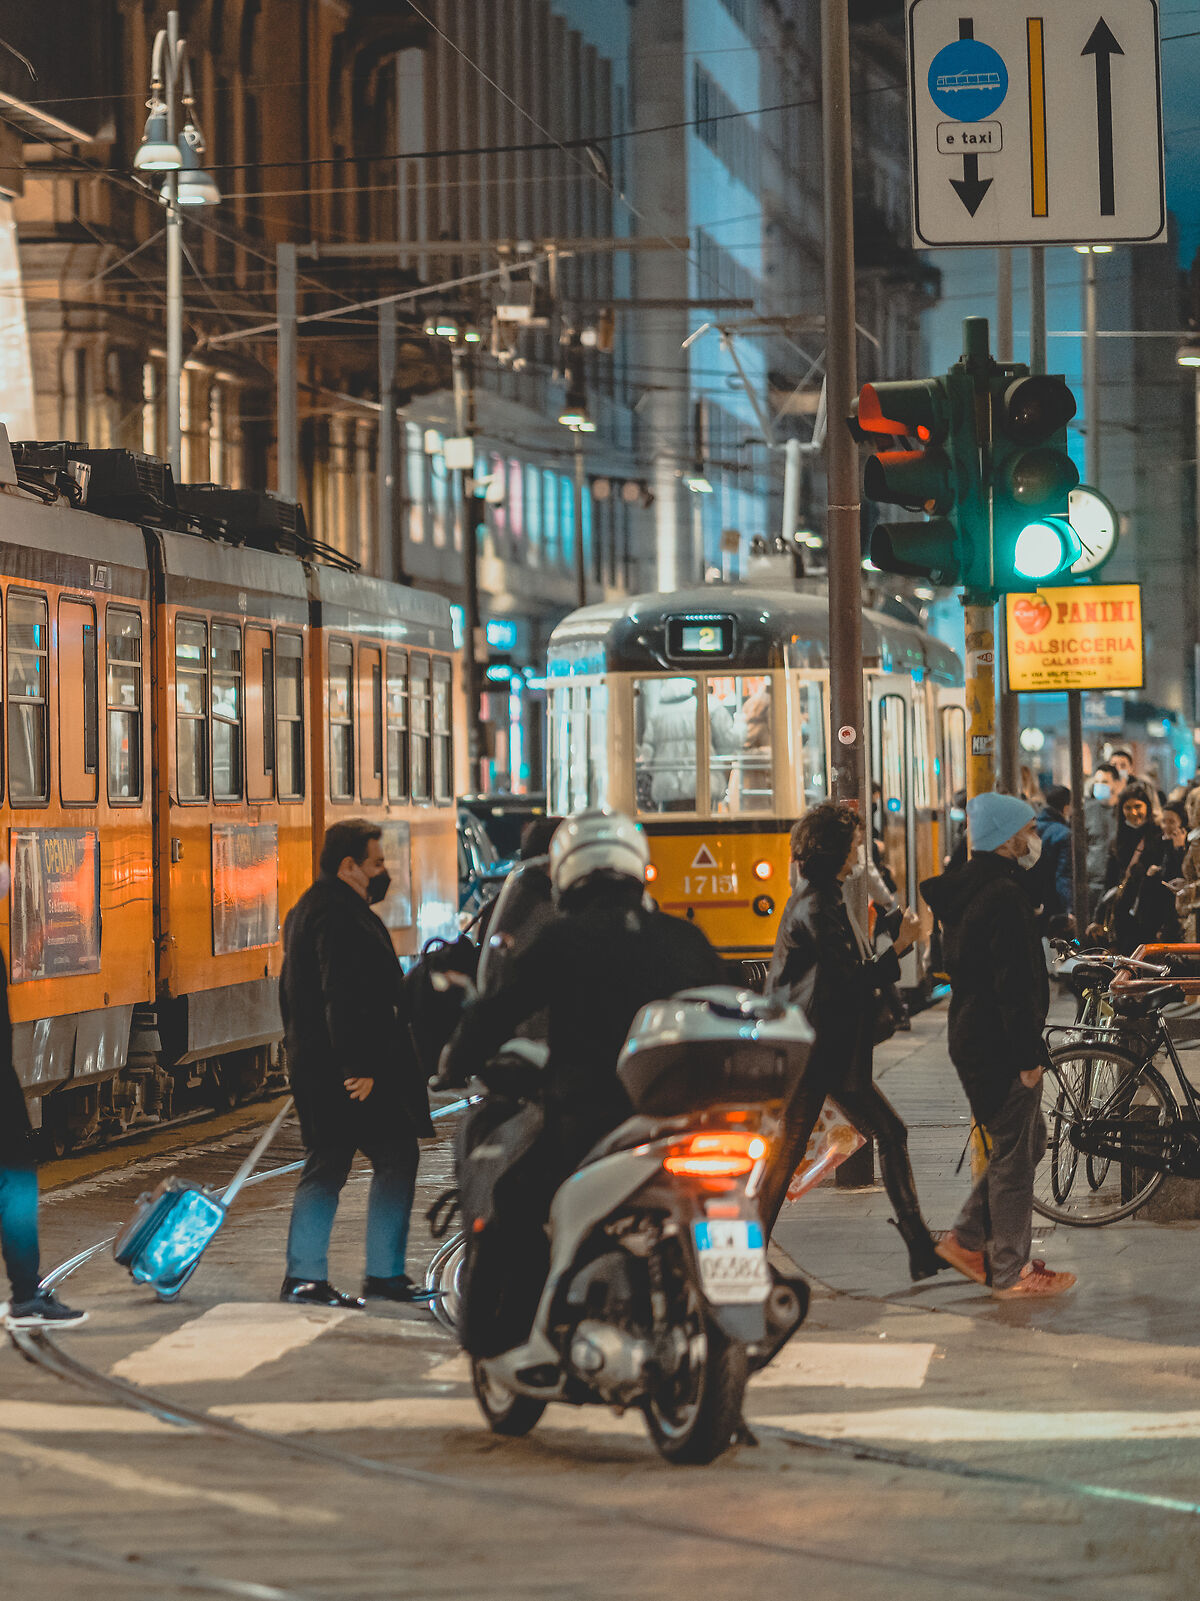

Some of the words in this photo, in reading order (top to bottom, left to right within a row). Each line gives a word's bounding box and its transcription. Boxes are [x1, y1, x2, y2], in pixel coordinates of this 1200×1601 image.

[946, 135, 955, 144] e
[961, 131, 992, 144] taxi
[1056, 600, 1135, 624] PANINI
[699, 627, 715, 651] 2
[1014, 637, 1136, 655] SALSICCERIA
